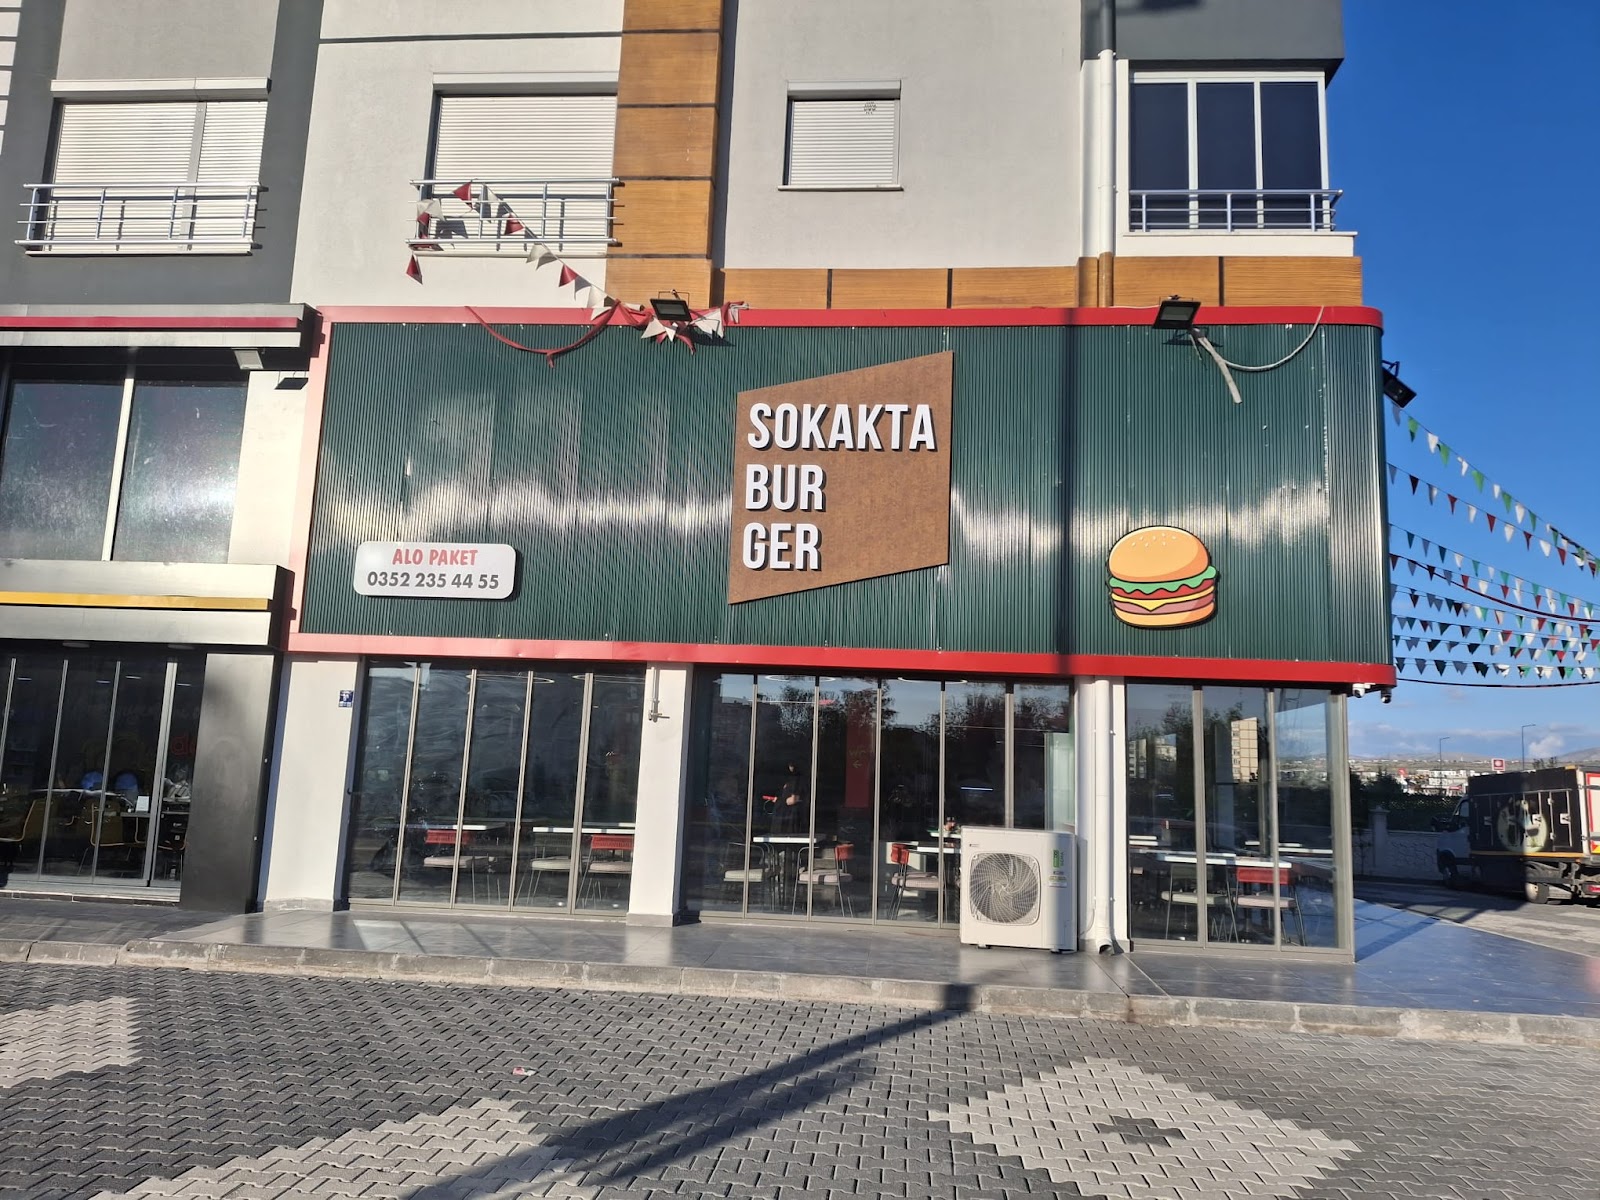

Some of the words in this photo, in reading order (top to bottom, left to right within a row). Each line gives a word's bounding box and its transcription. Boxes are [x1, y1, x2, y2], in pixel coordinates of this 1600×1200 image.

[747, 402, 936, 450] SOKAKTA
[745, 463, 824, 510] BUR
[392, 548, 423, 565] ALO
[429, 549, 478, 566] PAKET
[742, 522, 820, 570] GER
[367, 571, 410, 588] 0352
[415, 572, 447, 588] 235
[451, 573, 473, 589] 44
[478, 574, 499, 590] 55
